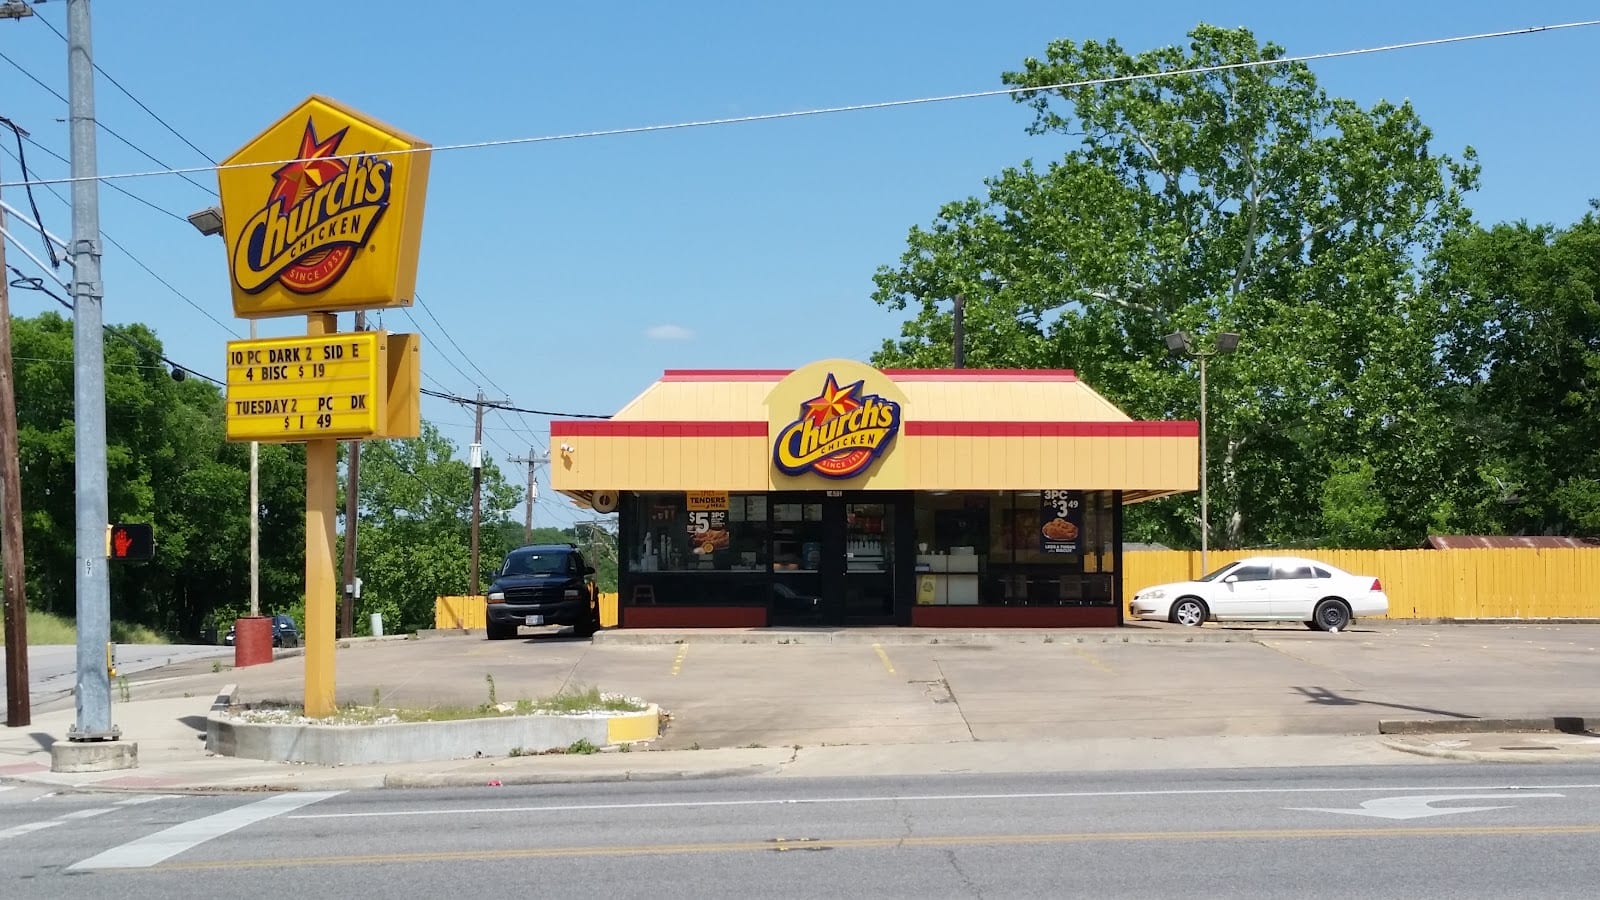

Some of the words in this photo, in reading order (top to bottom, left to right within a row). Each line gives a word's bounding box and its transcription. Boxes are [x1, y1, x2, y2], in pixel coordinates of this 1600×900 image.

[233, 154, 389, 290] Church's
[290, 214, 361, 258] CHICKEN
[289, 269, 320, 281] SINCE
[323, 249, 343, 273] 1952
[231, 351, 243, 365] 10
[247, 350, 262, 364] PC
[269, 347, 301, 363] DARK
[305, 347, 312, 361] 2
[324, 344, 343, 360] SID
[352, 343, 359, 358] E
[246, 367, 253, 381] 4
[261, 365, 288, 381] BISC
[298, 365, 304, 378] $
[313, 363, 325, 378] 19
[235, 398, 289, 415] TUESDAY
[291, 398, 297, 413] 2
[318, 396, 333, 411] PC
[351, 394, 366, 409] DK
[284, 415, 290, 430] $
[317, 413, 332, 428] 49
[778, 398, 893, 468] Church's
[820, 434, 876, 454] CHICKEN
[690, 496, 726, 504] TENDERS
[1044, 490, 1068, 500] 3PC
